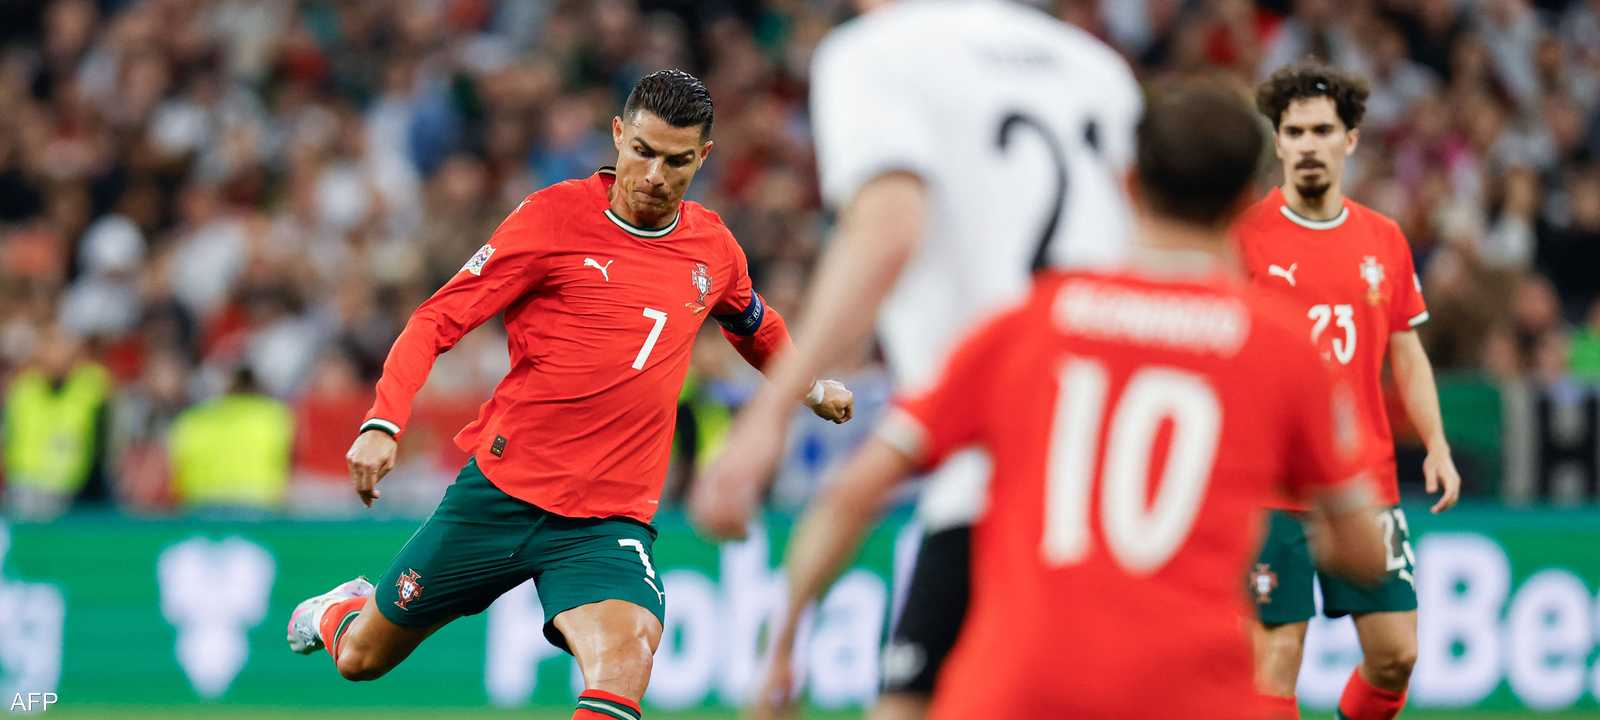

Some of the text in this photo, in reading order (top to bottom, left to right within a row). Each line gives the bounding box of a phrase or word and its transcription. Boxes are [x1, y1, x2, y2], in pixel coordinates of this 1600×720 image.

[631, 307, 668, 371] 7
[1040, 354, 1223, 576] 10
[617, 538, 656, 580] 7
